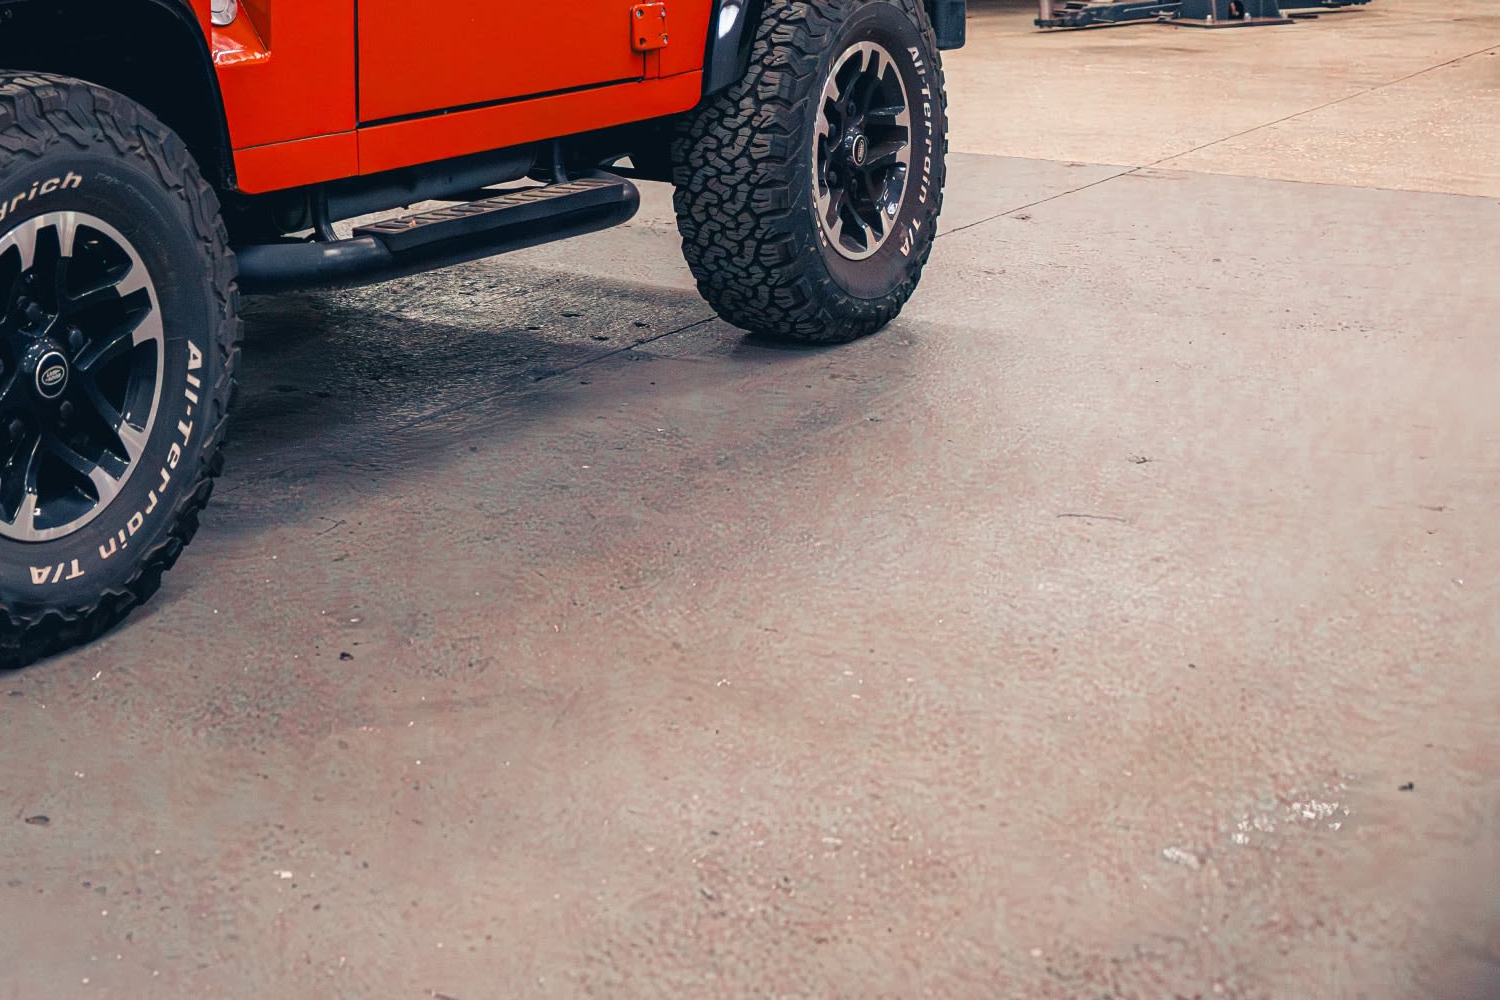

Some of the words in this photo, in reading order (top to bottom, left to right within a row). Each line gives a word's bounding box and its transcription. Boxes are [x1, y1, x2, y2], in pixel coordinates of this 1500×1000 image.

[907, 46, 932, 204] All-Terrain
[98, 340, 203, 560] All-Terrain
[29, 558, 85, 585] T/A
